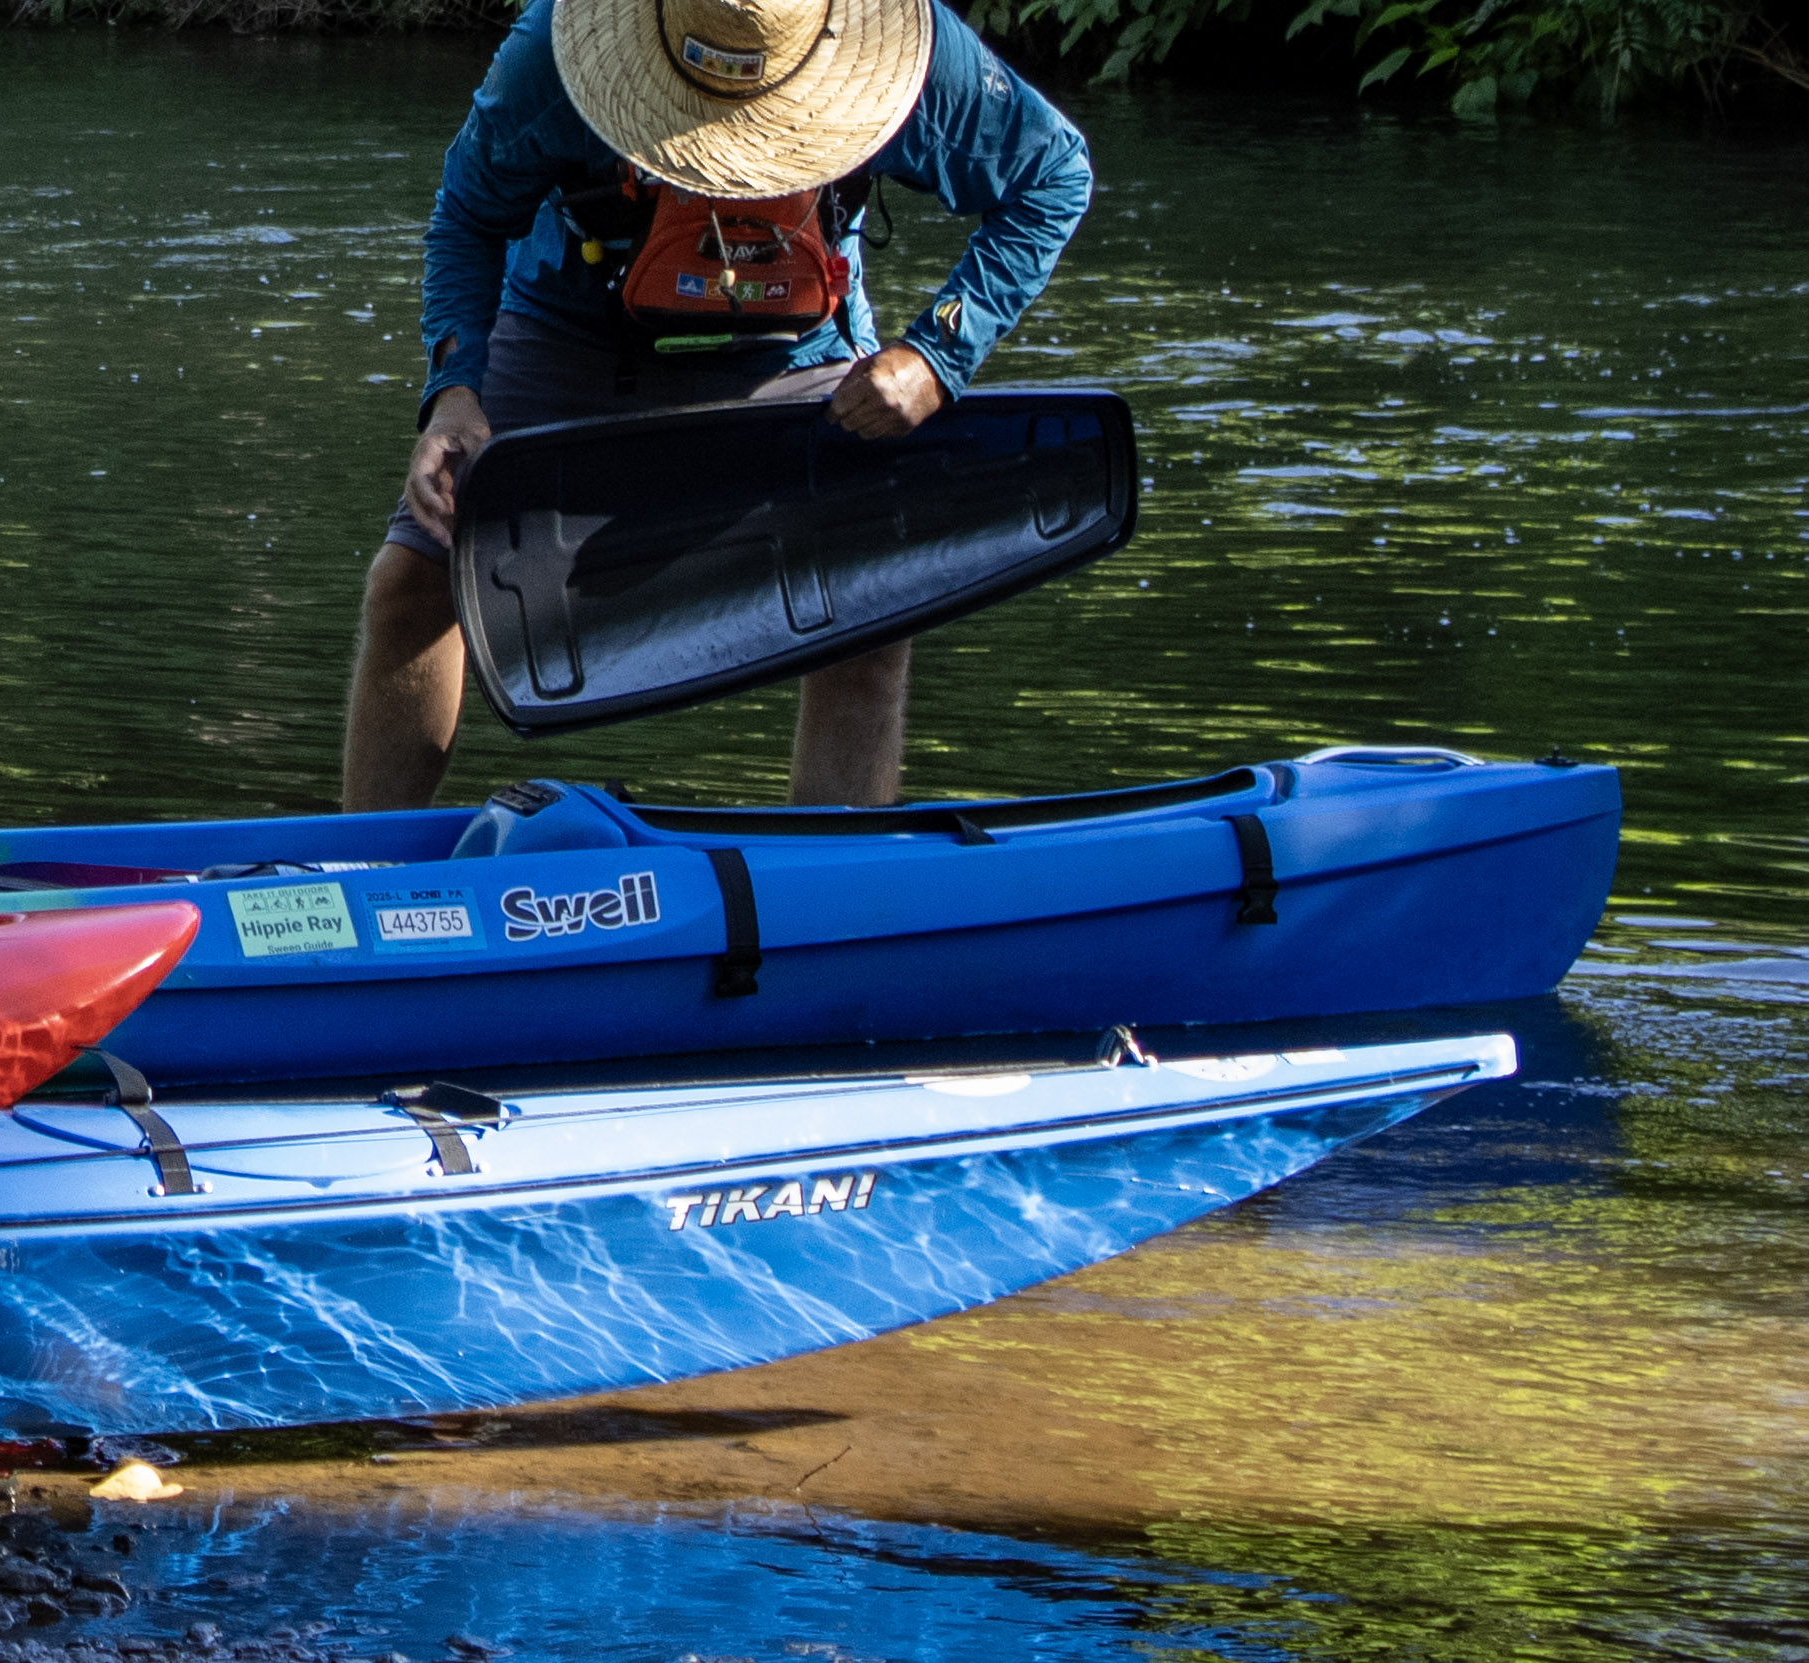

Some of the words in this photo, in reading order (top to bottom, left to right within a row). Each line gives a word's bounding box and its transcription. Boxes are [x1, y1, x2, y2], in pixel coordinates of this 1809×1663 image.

[723, 245, 757, 262] RAY
[278, 885, 330, 897] OUTDOORS
[366, 891, 402, 902] 2025-L
[500, 871, 661, 942] Swell
[242, 918, 302, 939] Hippie
[306, 915, 342, 933] Ray
[379, 910, 464, 934] L443755
[303, 940, 334, 951] Guide
[666, 1173, 878, 1232] TIKANI
